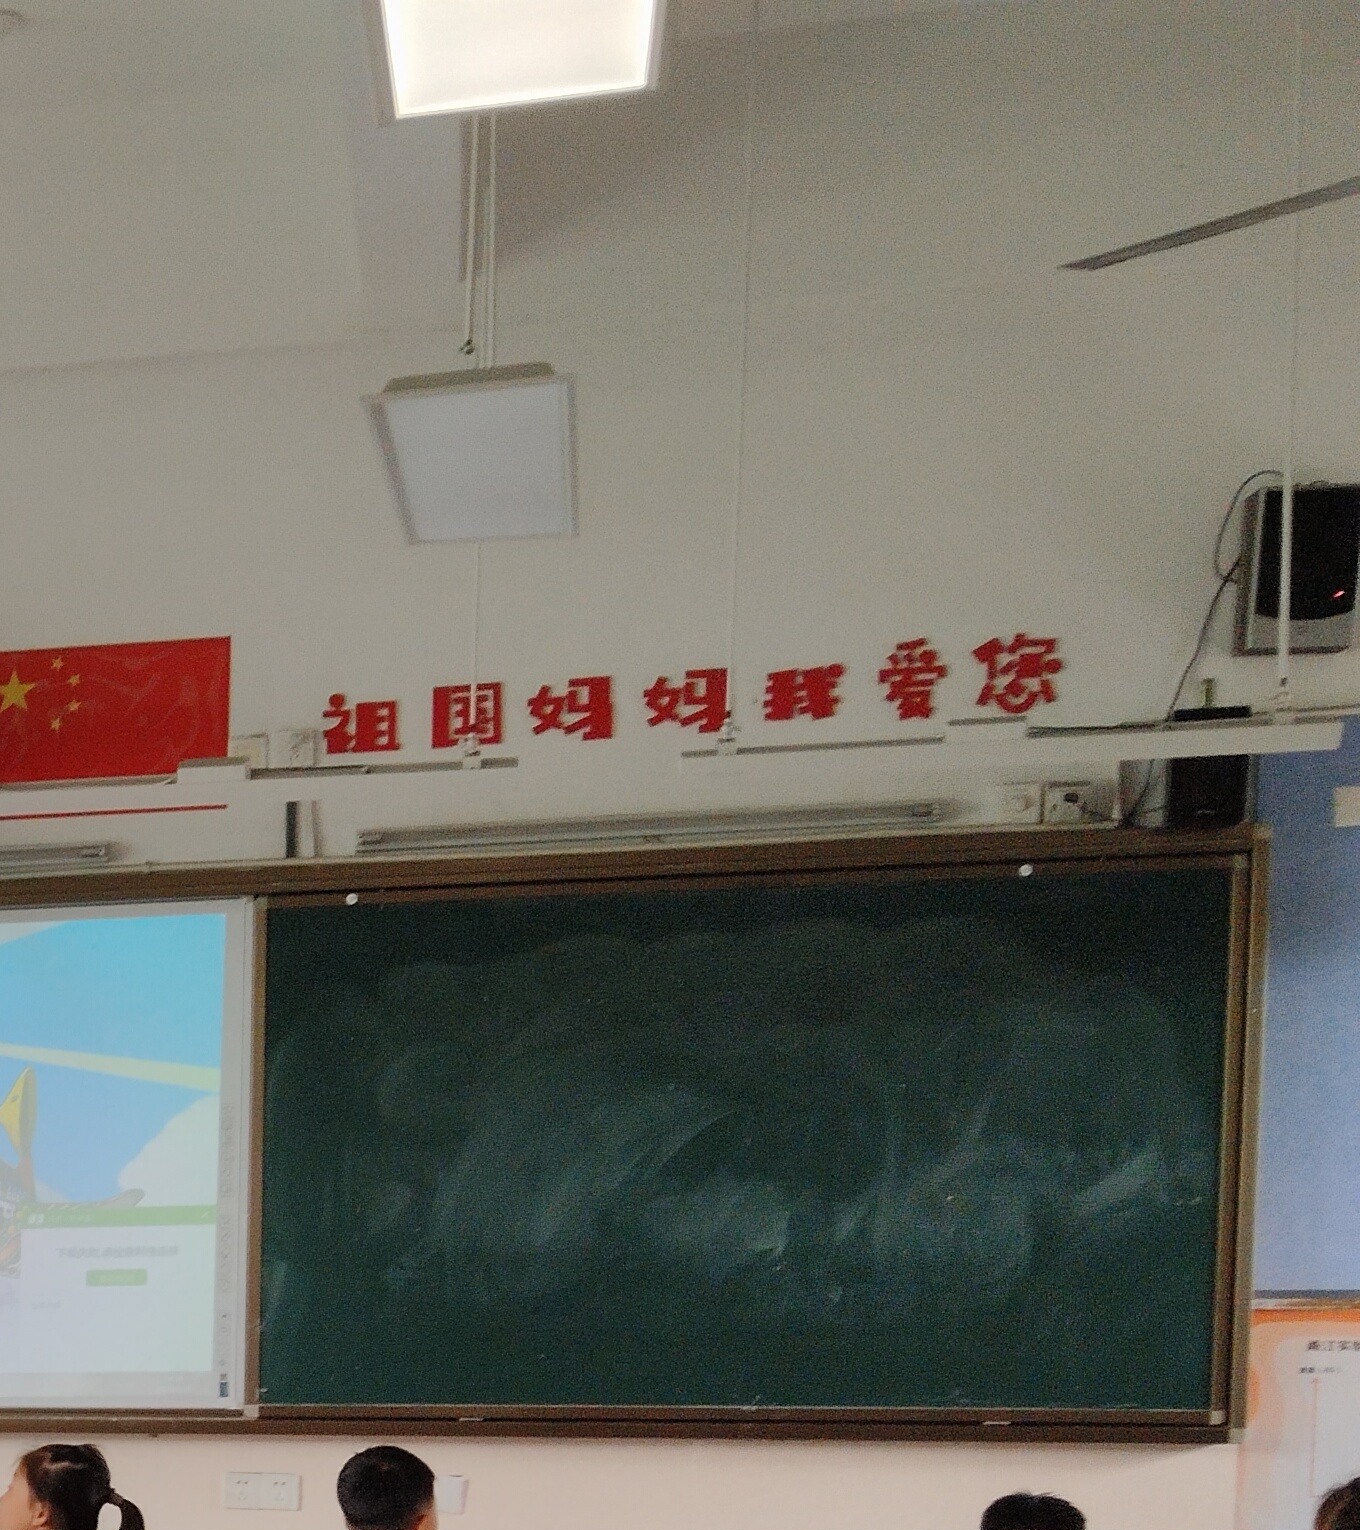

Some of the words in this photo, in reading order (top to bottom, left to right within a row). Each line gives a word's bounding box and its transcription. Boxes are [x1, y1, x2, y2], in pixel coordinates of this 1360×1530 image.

[322, 632, 1064, 754] 祖国妈妈我爱您
